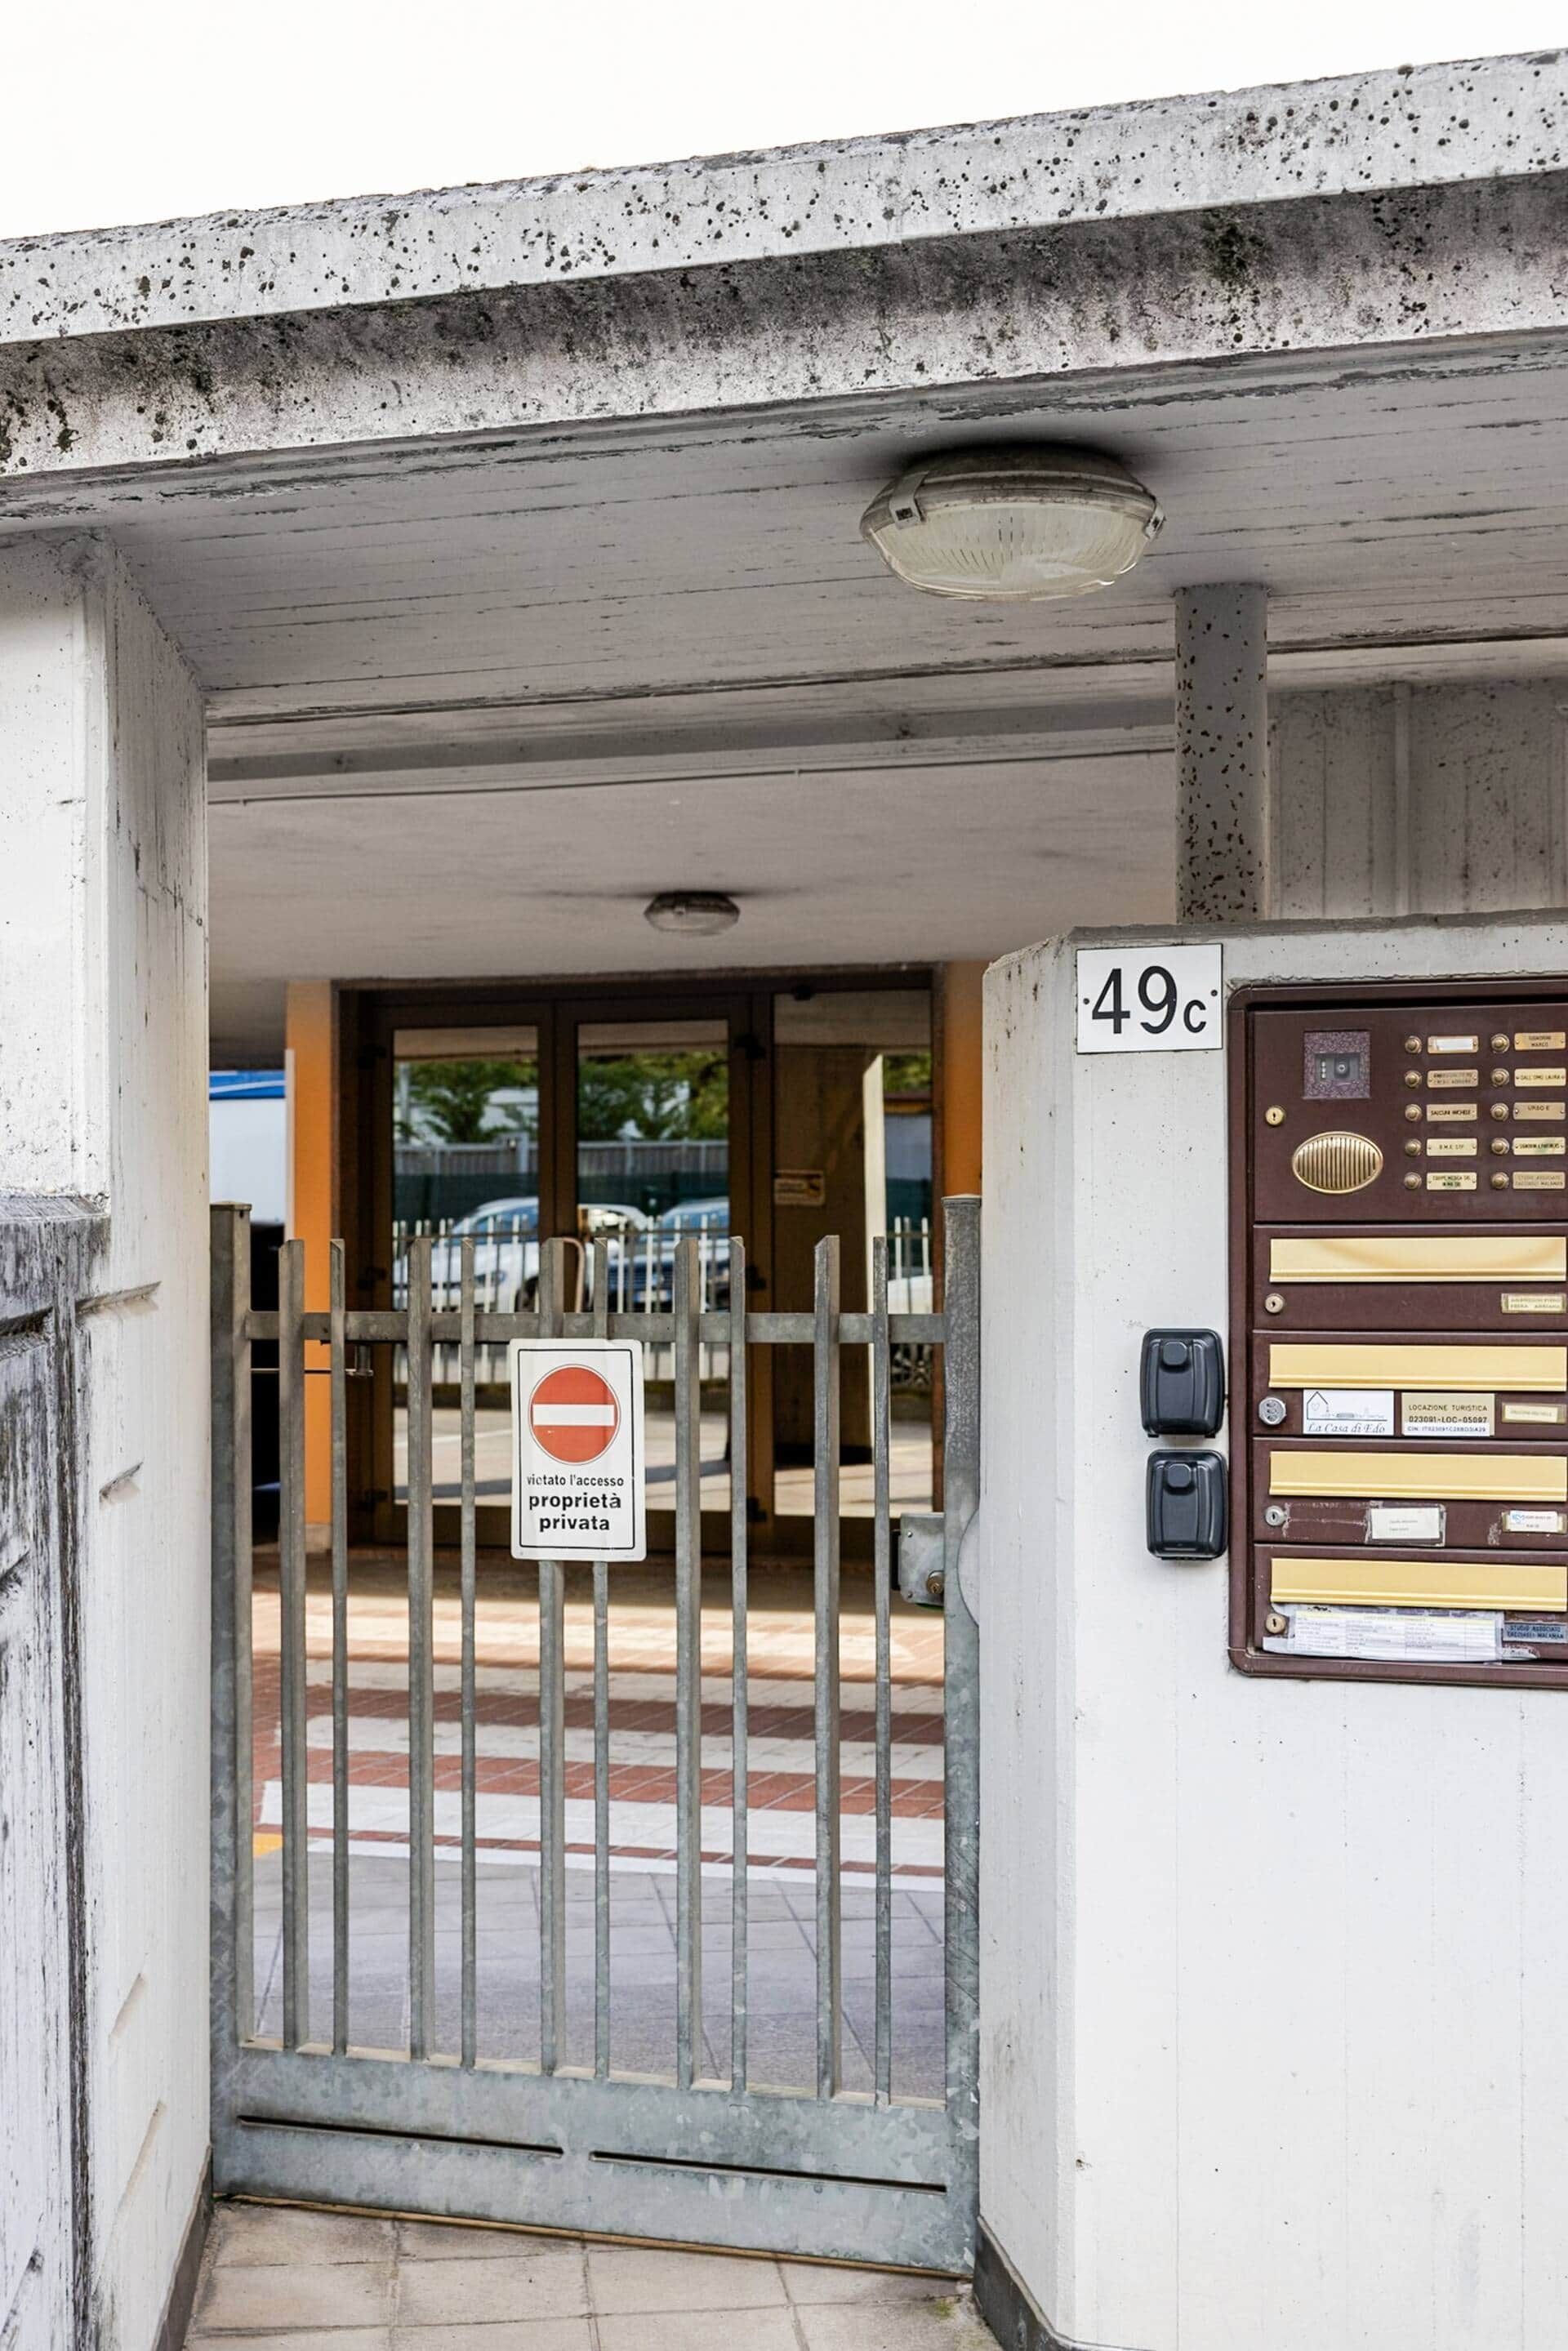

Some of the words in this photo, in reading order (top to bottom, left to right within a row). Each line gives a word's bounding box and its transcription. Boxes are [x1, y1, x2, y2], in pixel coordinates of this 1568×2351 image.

[1308, 1423, 1321, 1432] La
[1325, 1423, 1348, 1433] Casa
[1351, 1423, 1361, 1433] di
[528, 1474, 566, 1486] vietato
[569, 1474, 624, 1486] l'accesso
[529, 1492, 621, 1511] proprietà
[539, 1514, 610, 1532] privata
